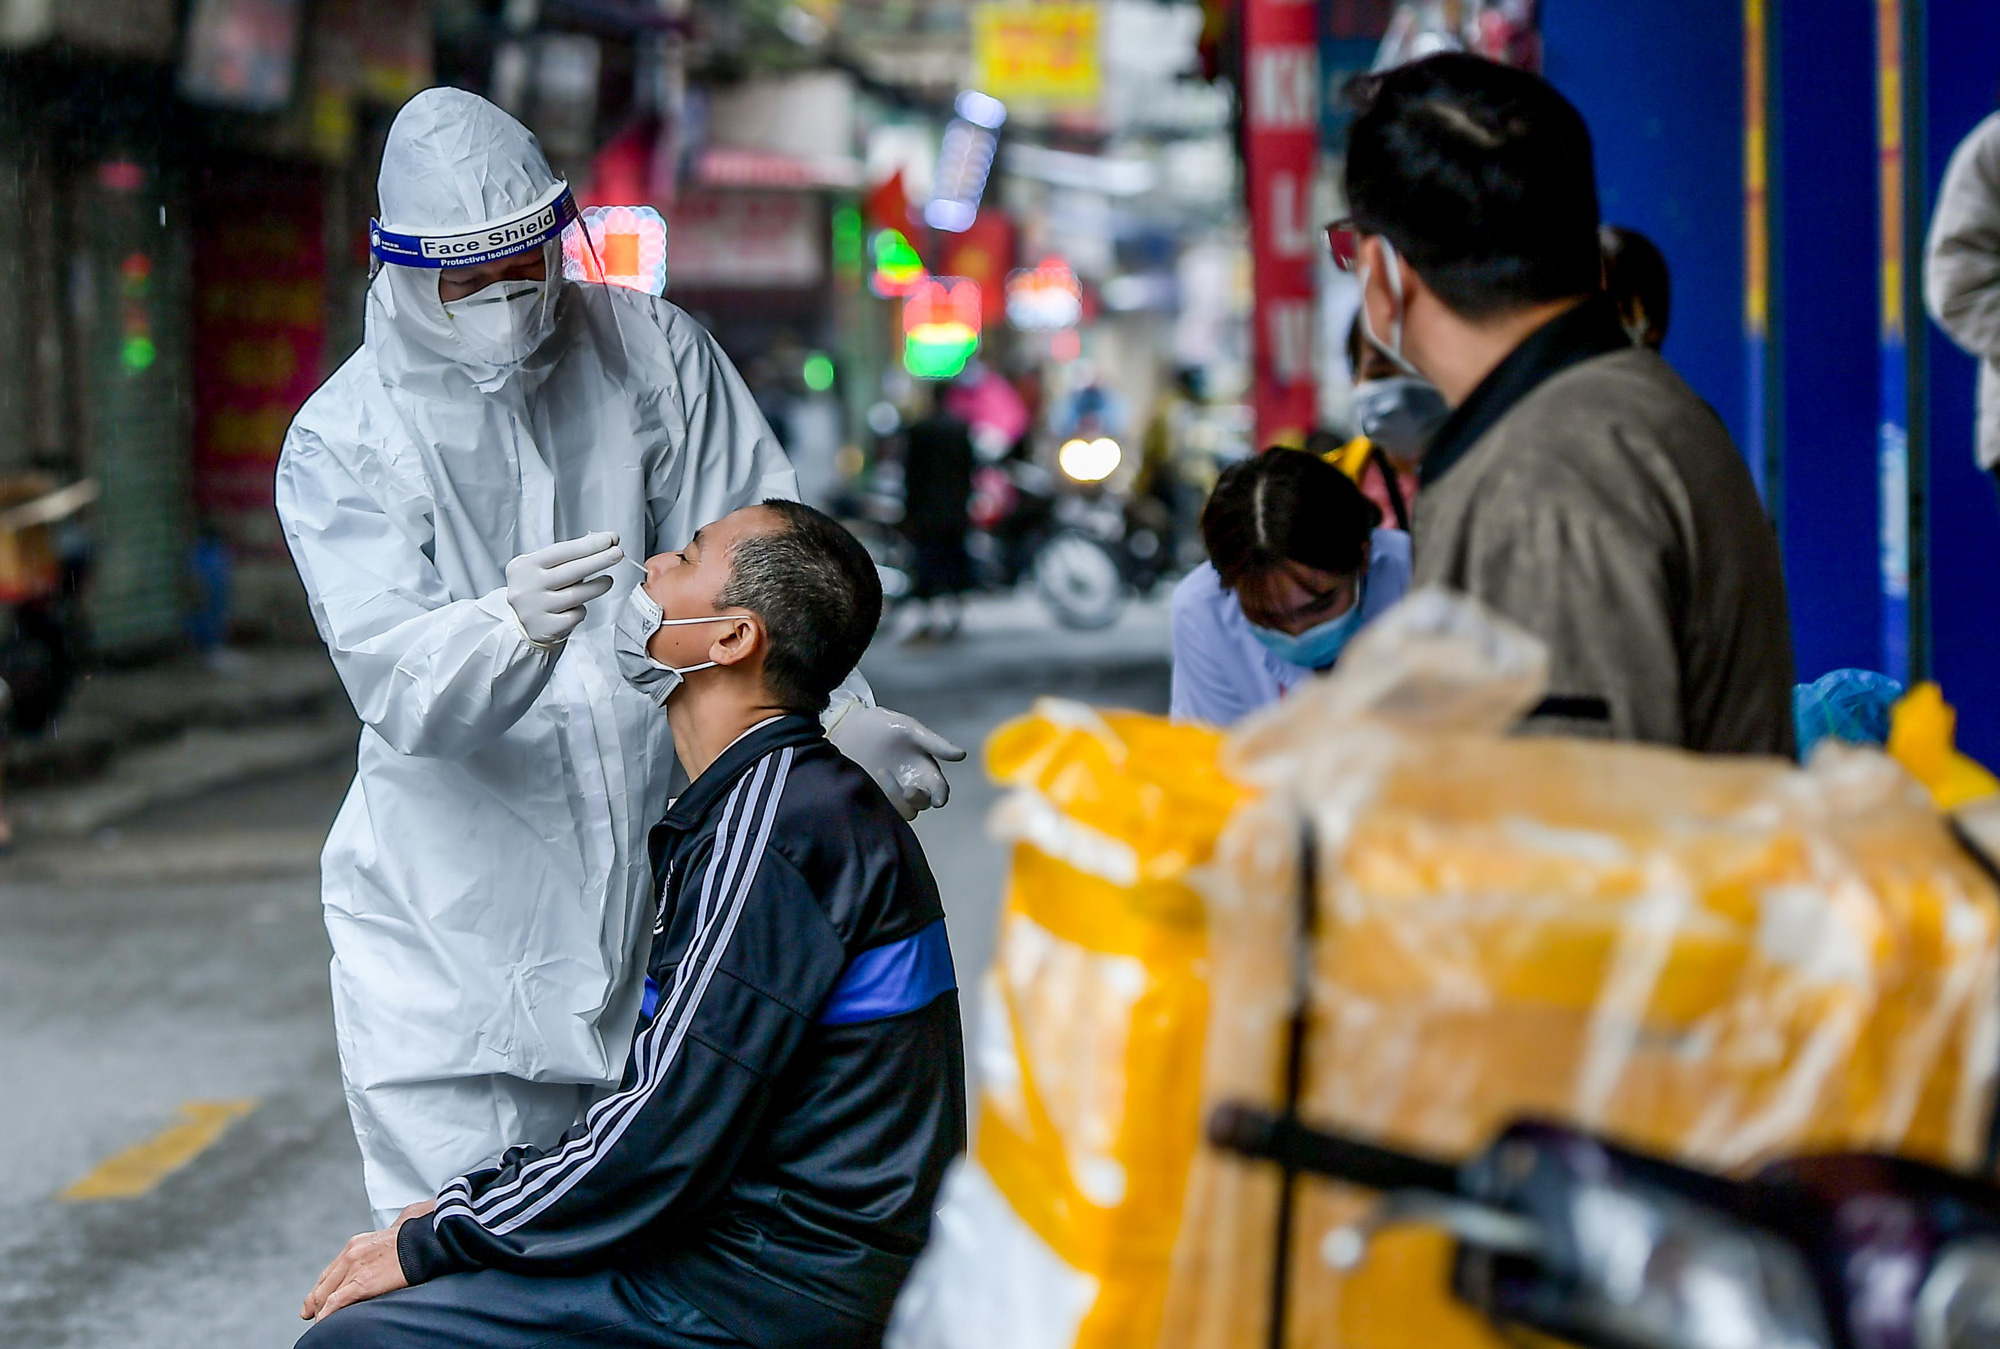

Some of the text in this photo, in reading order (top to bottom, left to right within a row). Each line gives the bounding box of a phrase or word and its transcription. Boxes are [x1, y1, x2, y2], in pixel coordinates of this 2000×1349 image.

[423, 241, 480, 255] Face
[488, 210, 554, 246] Shield
[440, 234, 547, 267] Protective Isolation Mask
